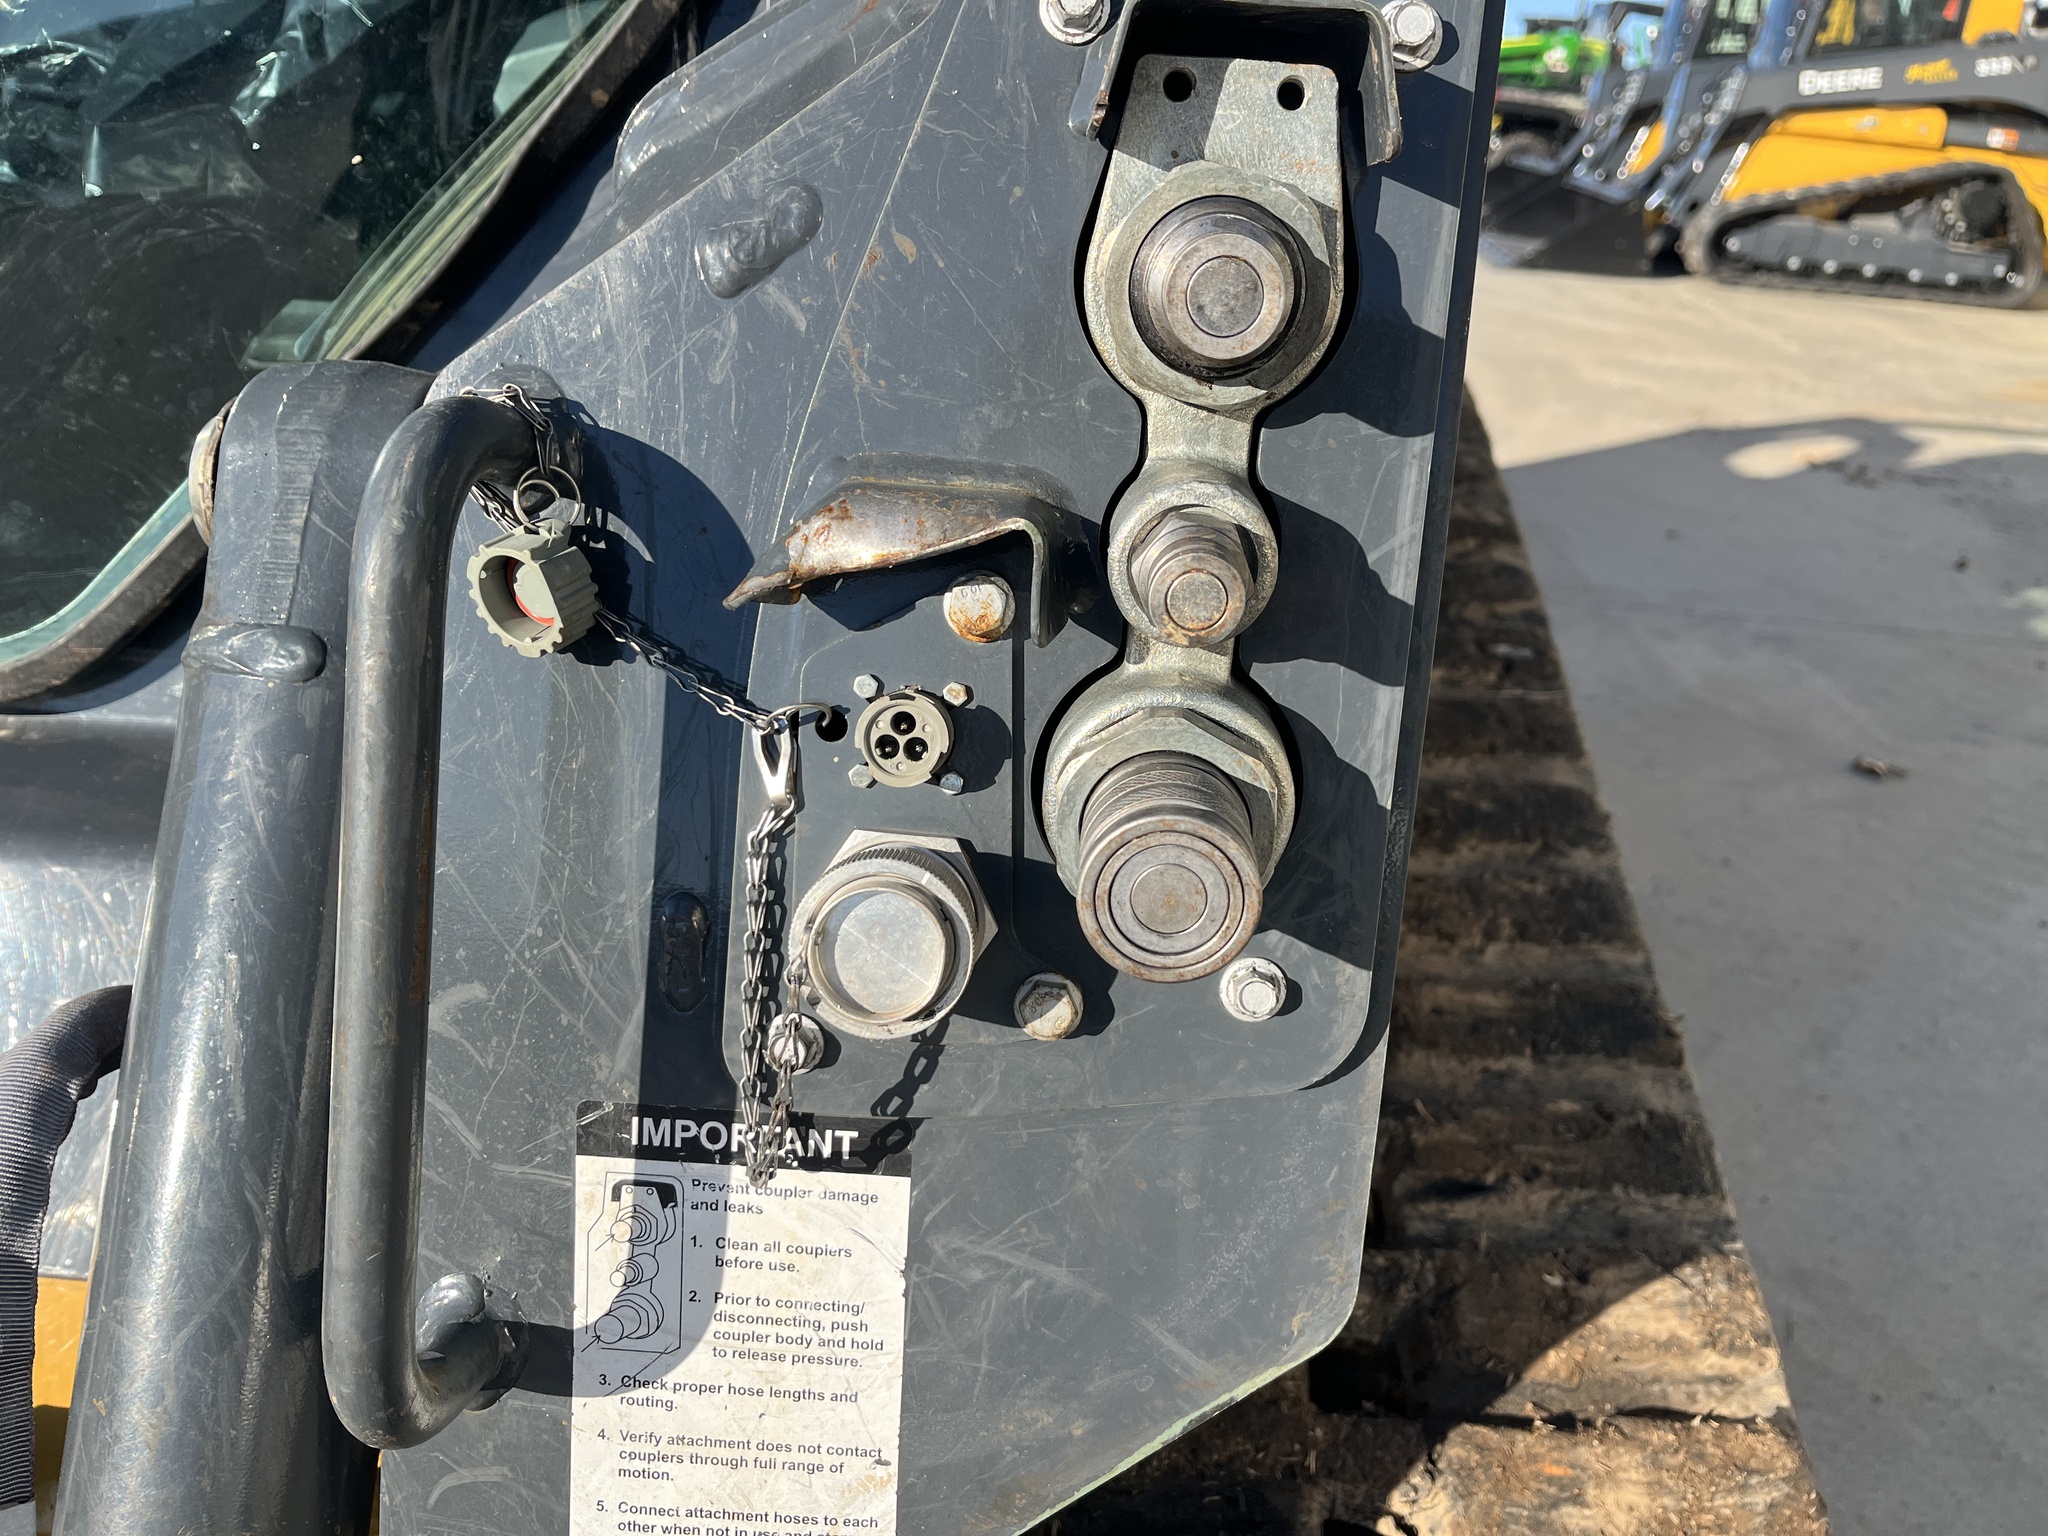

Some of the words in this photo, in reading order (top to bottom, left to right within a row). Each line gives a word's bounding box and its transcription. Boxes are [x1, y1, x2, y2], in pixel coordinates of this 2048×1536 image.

[1799, 66, 1884, 96] DEERE
[691, 1178, 750, 1195] Prevent
[755, 1184, 812, 1201] coupler
[818, 1189, 879, 1206] damage
[690, 1200, 719, 1212] and
[723, 1199, 764, 1215] leaks
[690, 1237, 703, 1249] 1.
[715, 1237, 759, 1253] Clean
[763, 1240, 781, 1253] all
[715, 1255, 764, 1272] before
[769, 1260, 800, 1274] use.
[688, 1290, 702, 1303] 2.
[714, 1291, 752, 1307] Prior
[755, 1295, 770, 1308] to
[774, 1297, 866, 1316] connecting/
[713, 1309, 826, 1331] disconnecting,
[830, 1319, 869, 1334] push
[713, 1329, 771, 1345] coupler
[774, 1332, 813, 1349] body
[817, 1335, 847, 1349] and
[850, 1336, 884, 1351] hold
[712, 1347, 727, 1359] to
[731, 1347, 787, 1363] release
[791, 1353, 863, 1368] pressure.
[598, 1374, 612, 1386] 3.
[620, 1374, 669, 1391] Check
[672, 1380, 724, 1395] proper
[727, 1382, 765, 1397] hose
[769, 1385, 825, 1402] lengths
[829, 1390, 859, 1404] and
[619, 1395, 679, 1412] routing.
[597, 1428, 610, 1441] 4.
[619, 1429, 663, 1447] Verify
[666, 1433, 752, 1451] attachment
[755, 1439, 793, 1454] does
[797, 1443, 823, 1456] not
[826, 1444, 883, 1459] contact
[619, 1448, 684, 1466] couplers
[689, 1452, 749, 1471] through
[781, 1460, 824, 1476] range
[828, 1462, 845, 1475] of
[618, 1466, 675, 1482] motion.
[596, 1500, 609, 1513] 5.
[618, 1500, 681, 1518] Connect
[684, 1504, 770, 1524] attachment
[773, 1511, 819, 1527] hoses
[823, 1514, 839, 1527] to
[842, 1515, 879, 1530] each
[617, 1519, 657, 1534] other
[661, 1522, 702, 1536] when
[706, 1526, 731, 1536] not
